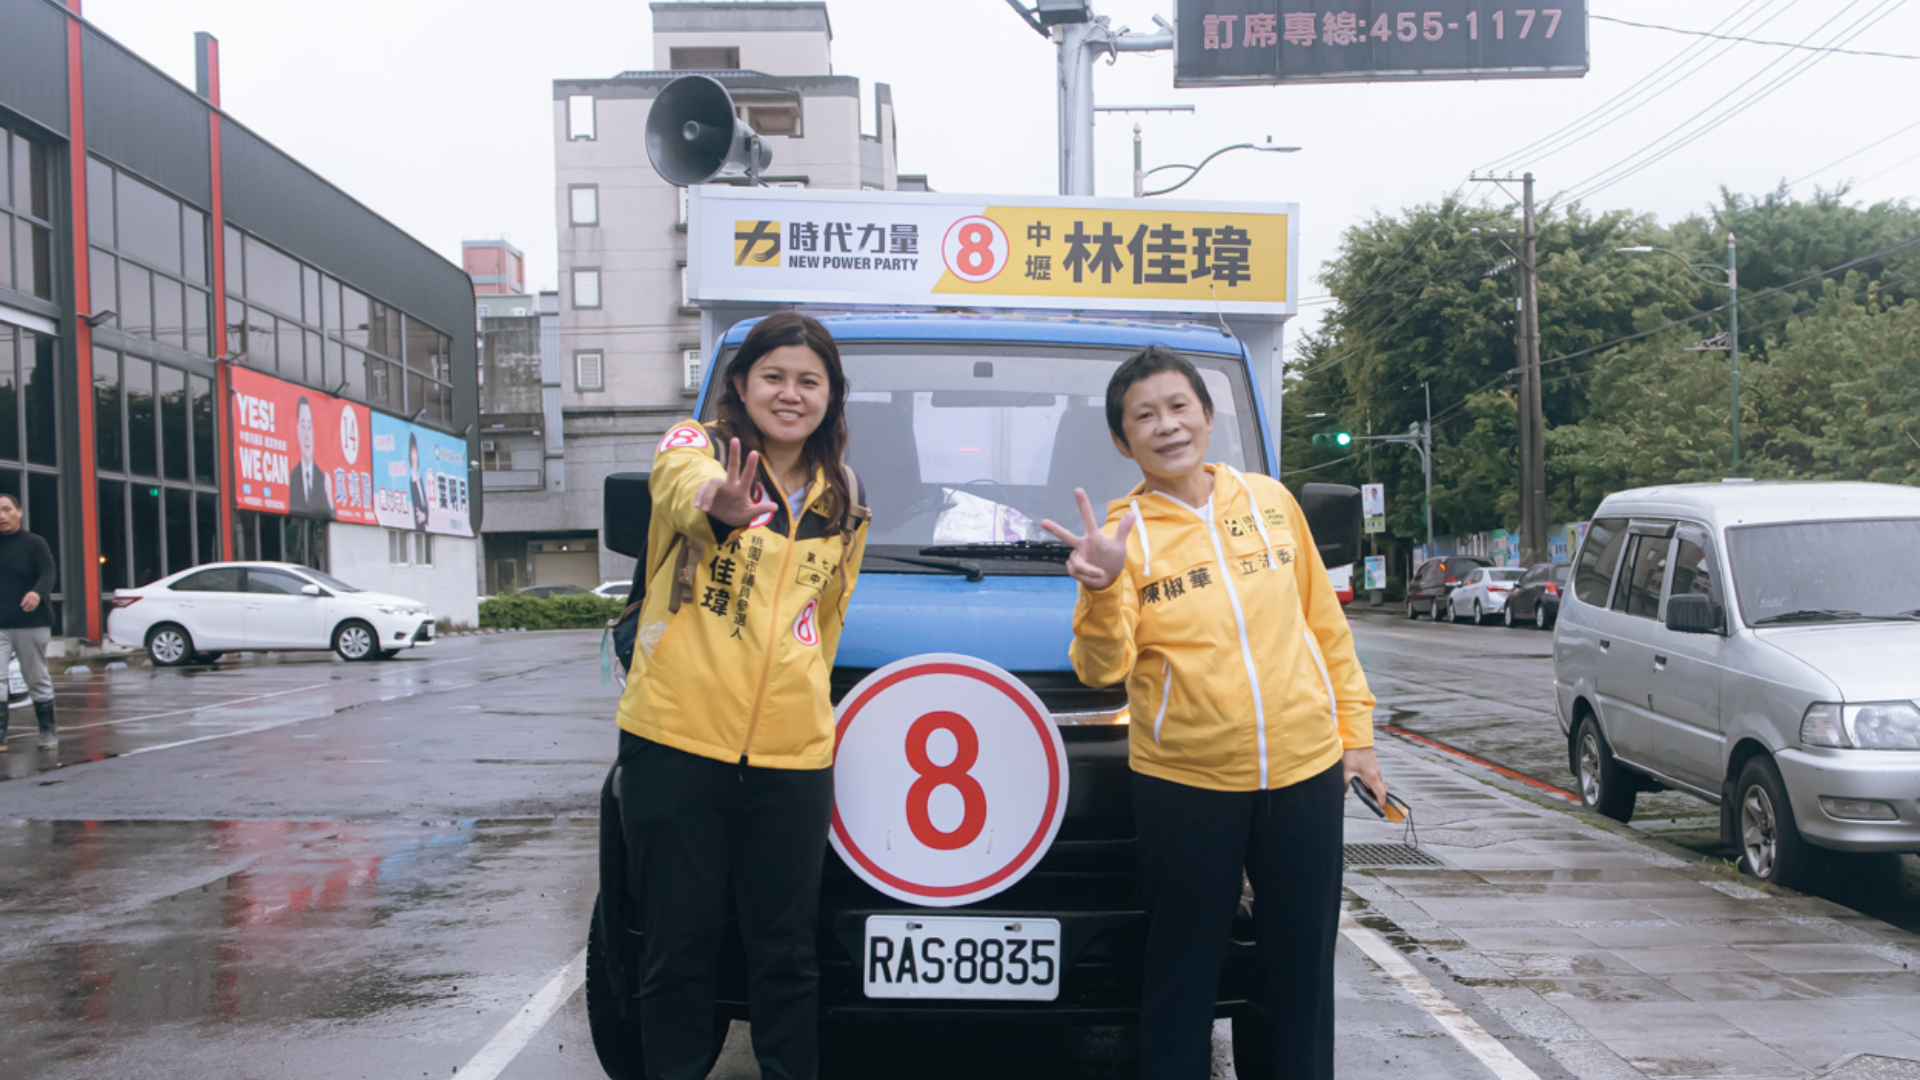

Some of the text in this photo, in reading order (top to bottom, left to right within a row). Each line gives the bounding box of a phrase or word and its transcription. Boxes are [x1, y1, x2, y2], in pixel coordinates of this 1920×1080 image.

[1202, 9, 1563, 50] 訂席專線:455-1177
[789, 221, 919, 255] 時代力量
[956, 222, 995, 276] 8
[1062, 221, 1252, 287] 林佳瑋
[789, 255, 918, 271] NEW POWER PARTY
[236, 392, 275, 433] YES!
[239, 446, 290, 486] WE CAN
[904, 710, 988, 851] 8
